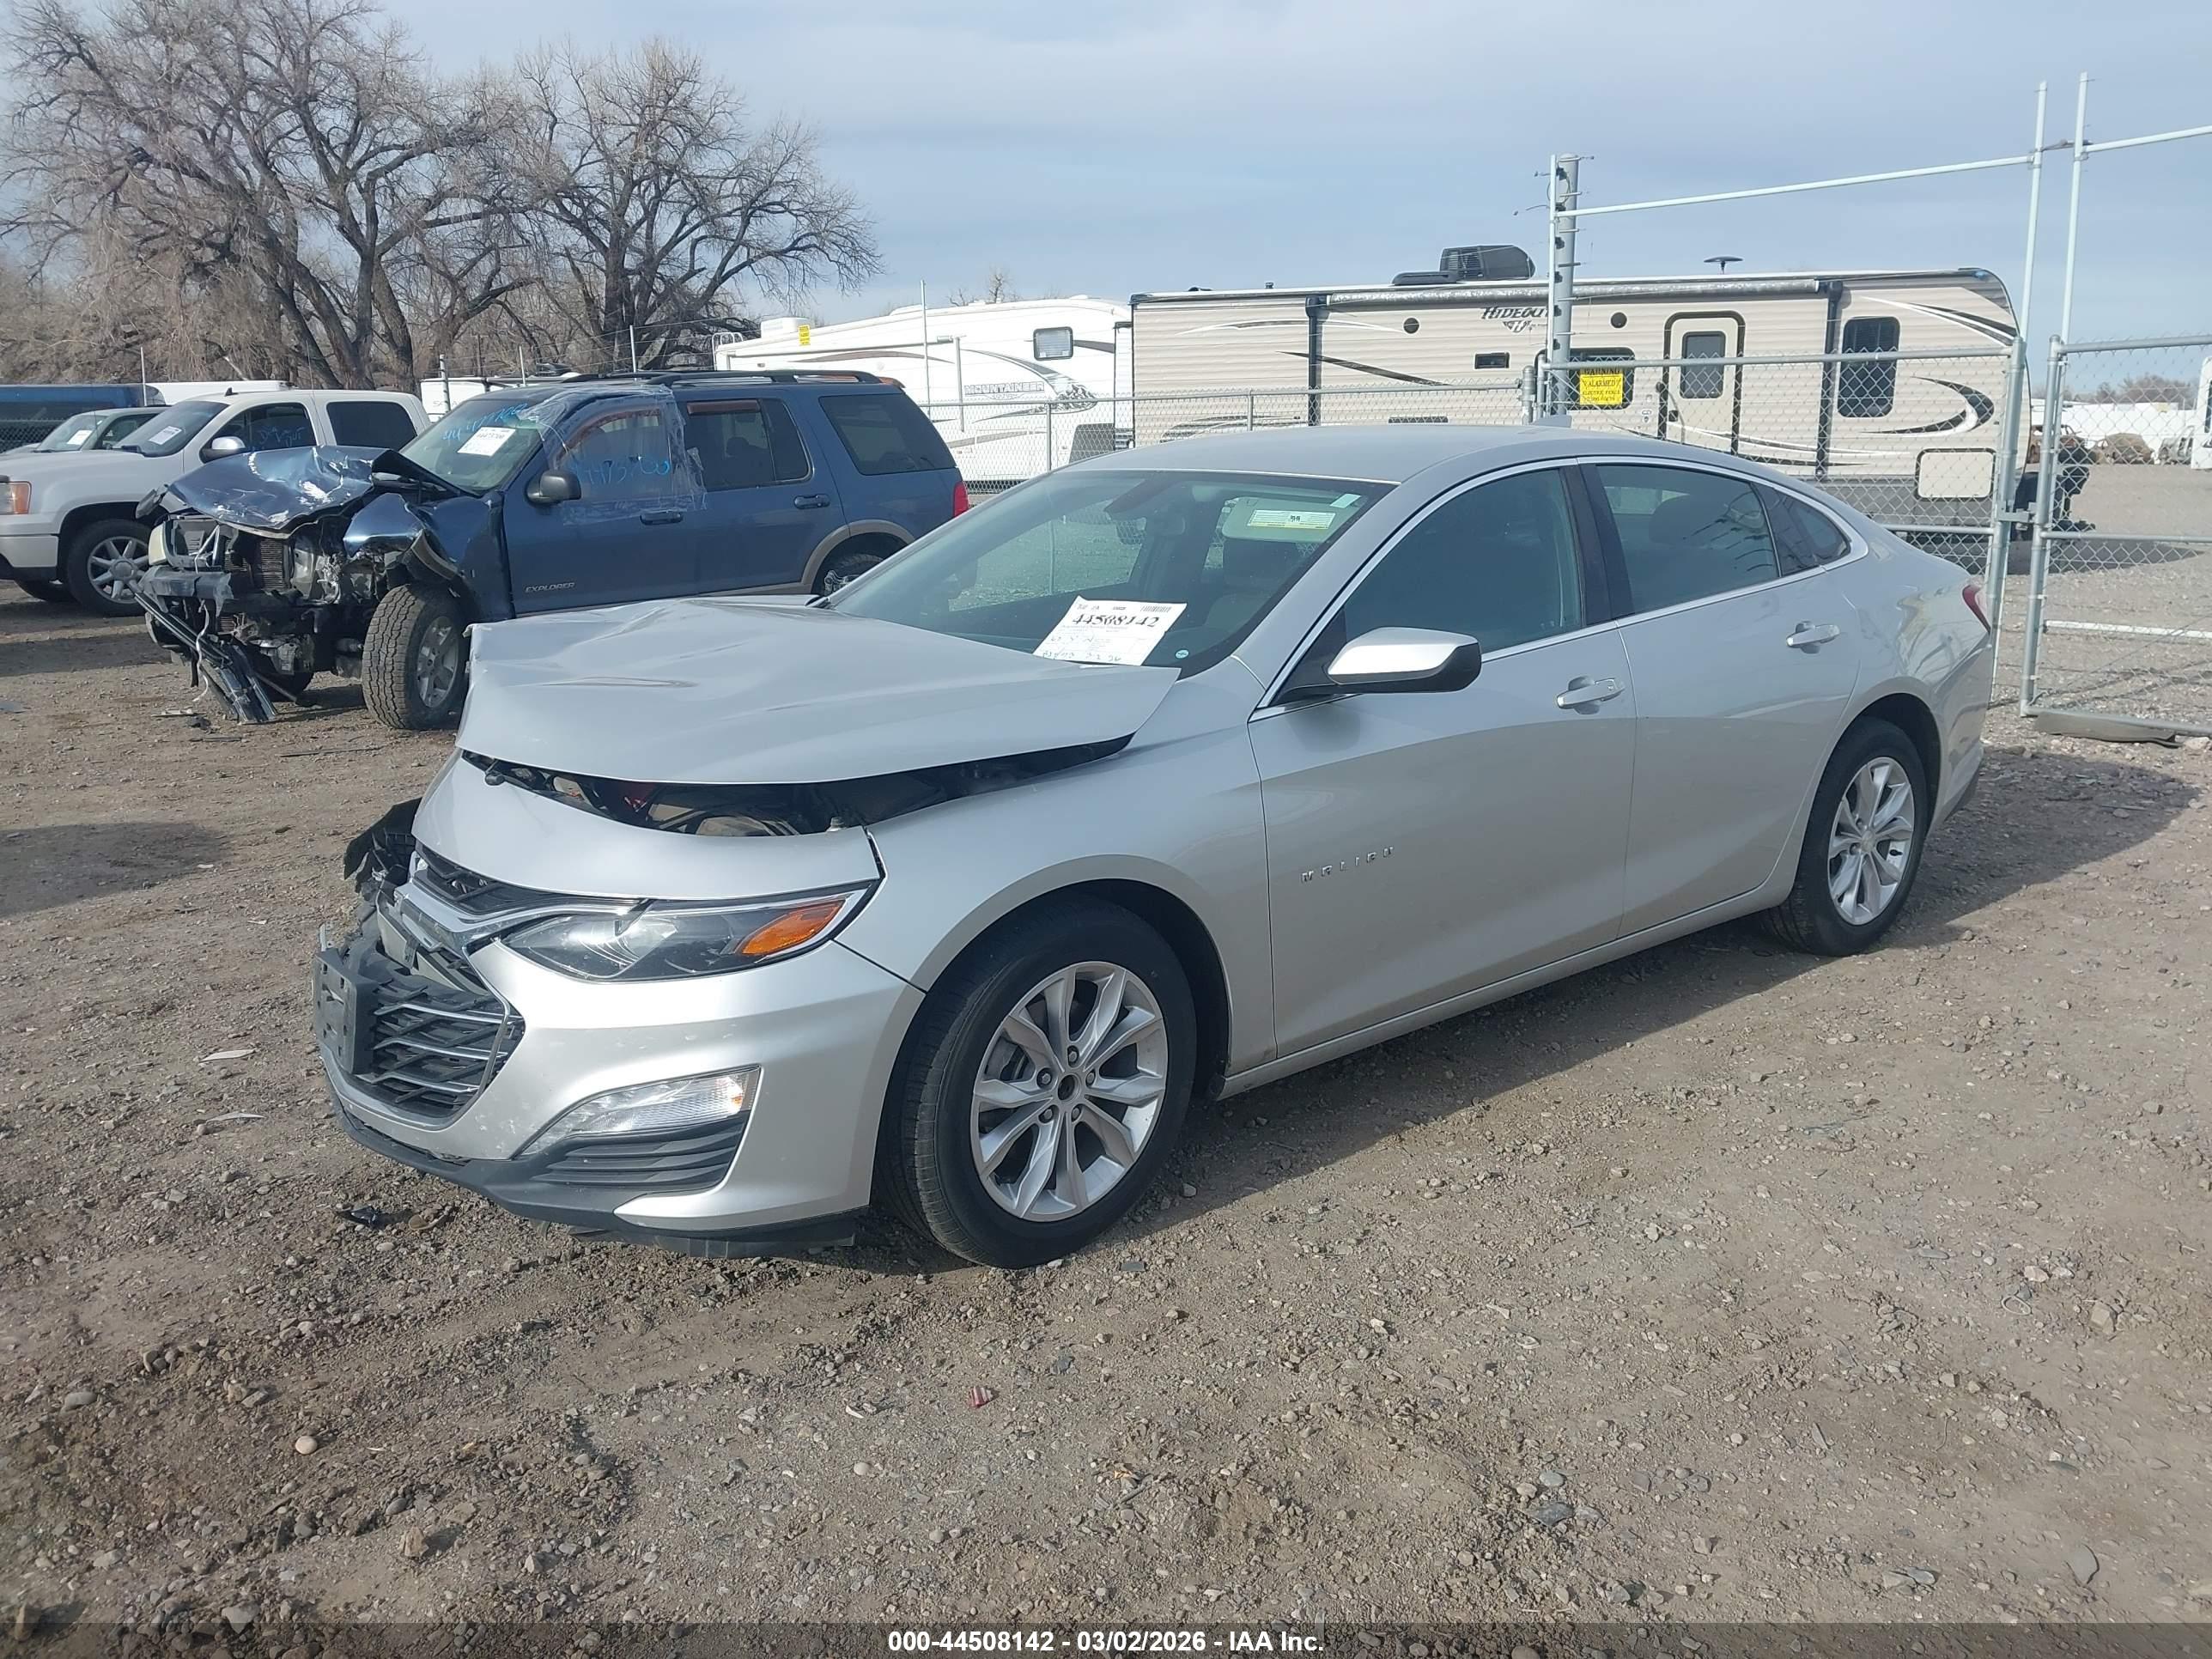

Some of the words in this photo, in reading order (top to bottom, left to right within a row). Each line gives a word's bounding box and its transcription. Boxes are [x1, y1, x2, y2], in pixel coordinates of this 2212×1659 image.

[1481, 307, 1548, 319] HIDEOU
[963, 381, 1045, 395] MOUNTAINEER
[525, 581, 576, 593] EXPLORER
[1072, 613, 1160, 628] 44508142
